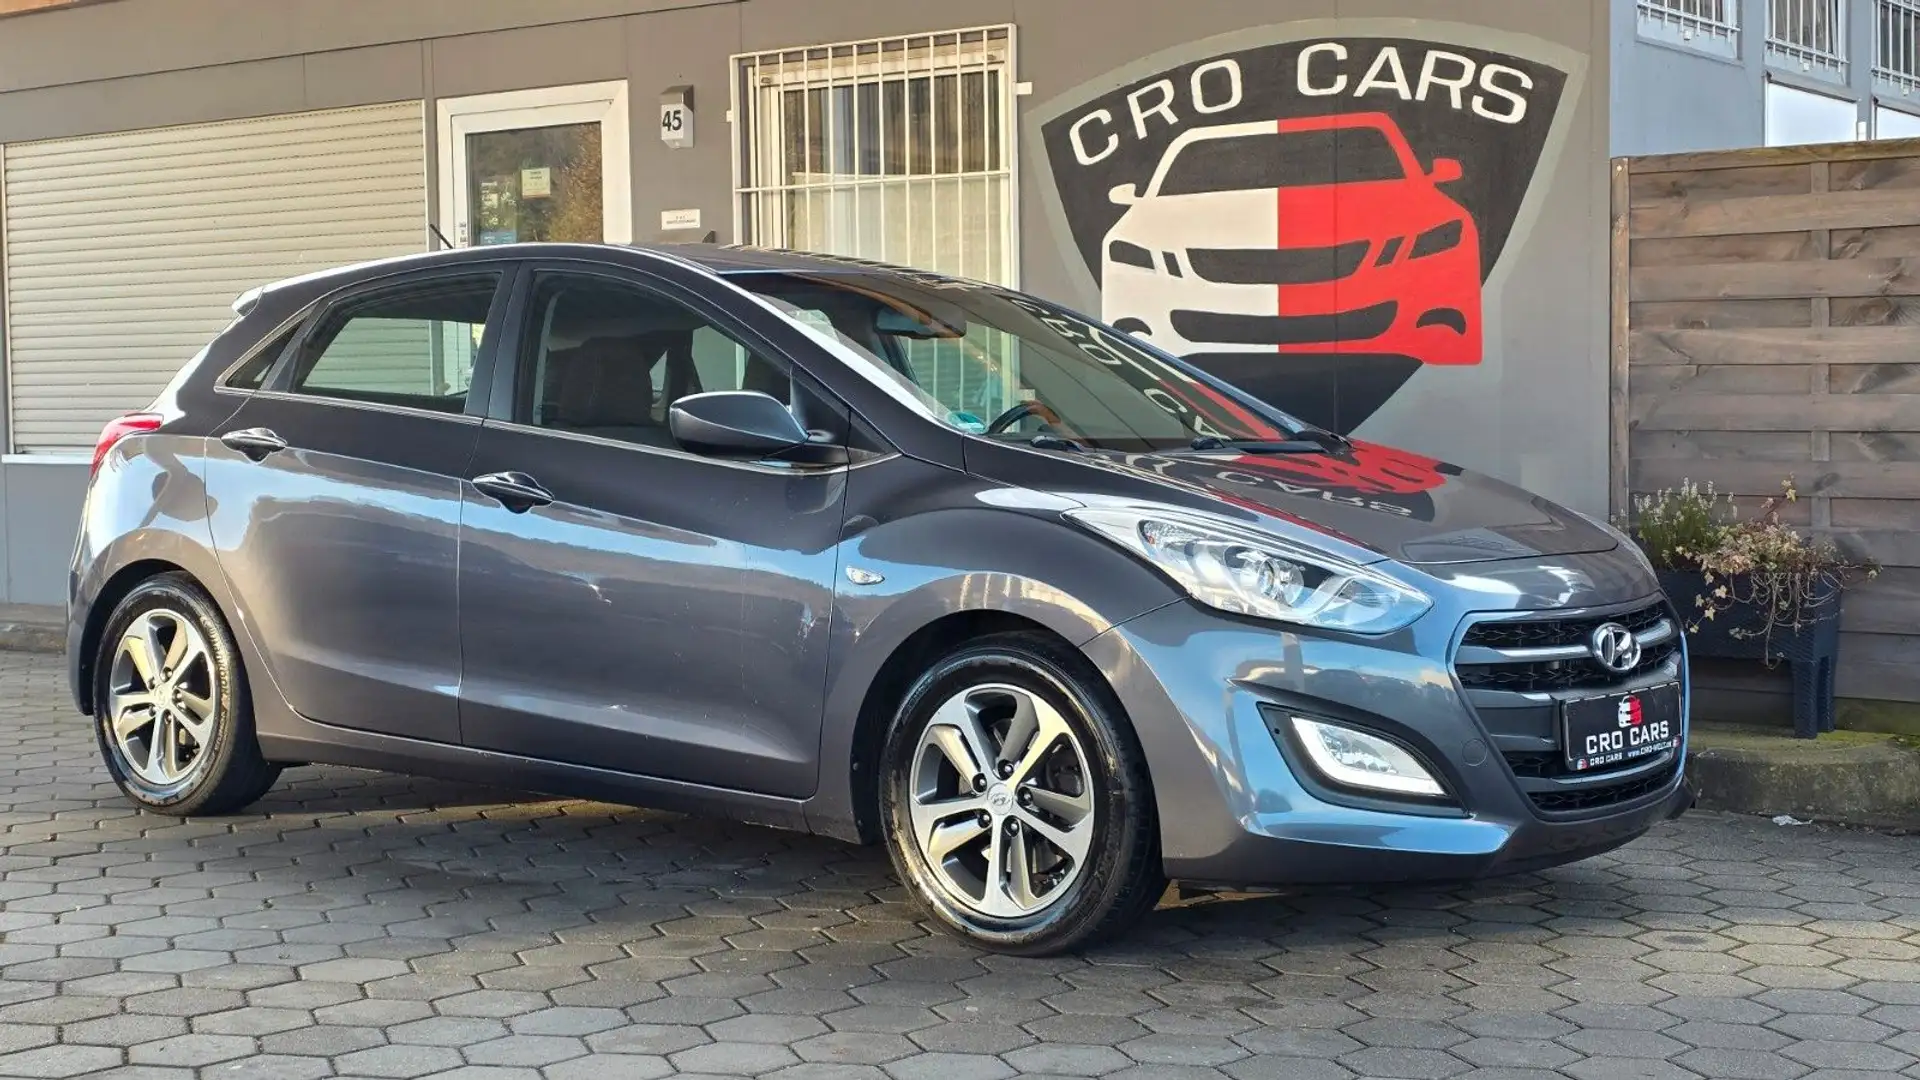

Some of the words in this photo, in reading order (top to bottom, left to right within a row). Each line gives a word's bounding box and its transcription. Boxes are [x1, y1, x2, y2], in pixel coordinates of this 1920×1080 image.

[1069, 59, 1241, 166] CRO
[1296, 43, 1534, 124] CARS
[662, 109, 682, 131] 45
[1586, 731, 1623, 754] CRO
[1630, 720, 1669, 746] CARS
[1589, 755, 1605, 766] CRO
[1605, 752, 1622, 763] CARS
